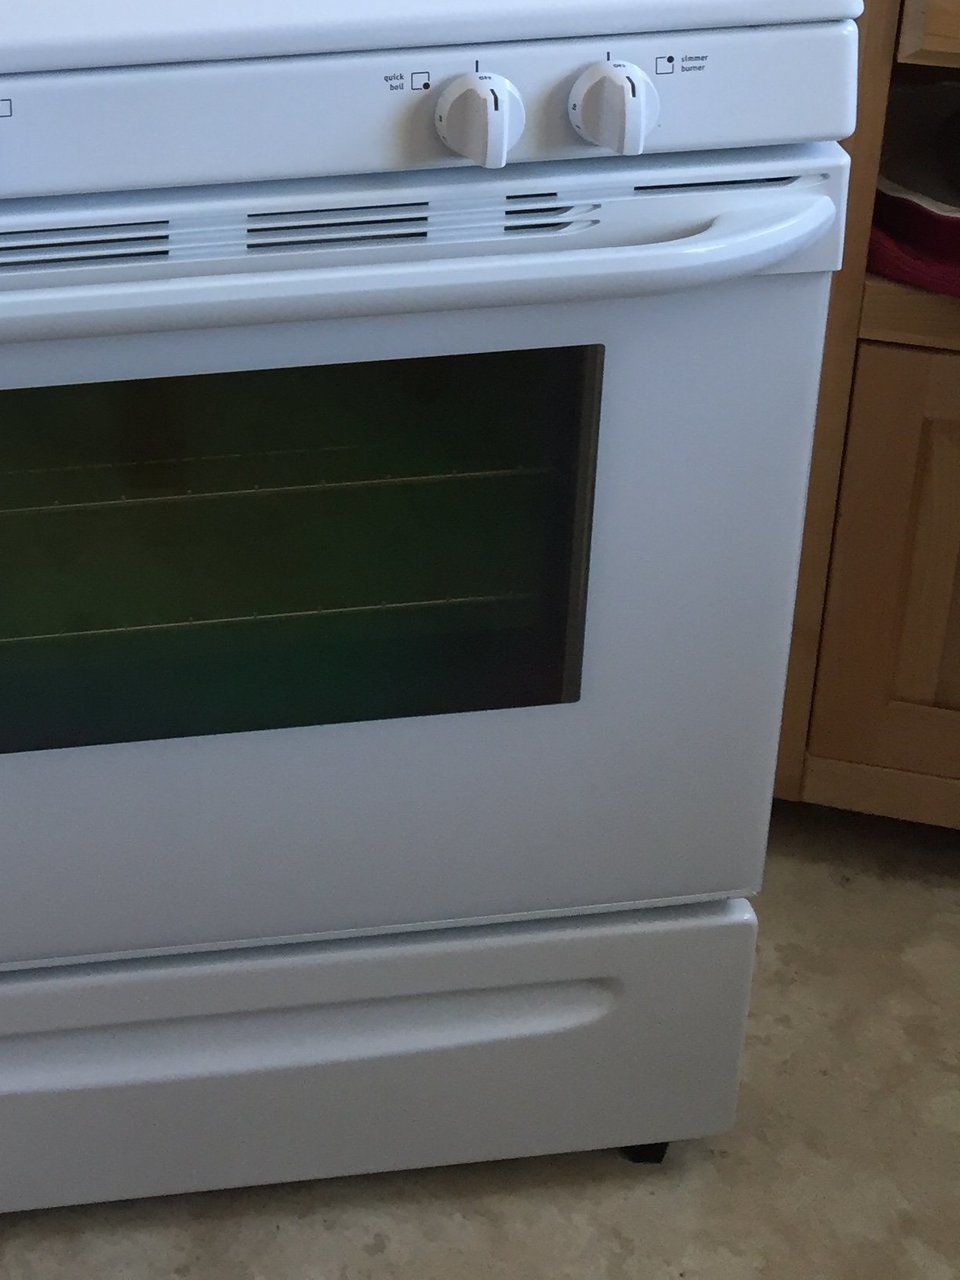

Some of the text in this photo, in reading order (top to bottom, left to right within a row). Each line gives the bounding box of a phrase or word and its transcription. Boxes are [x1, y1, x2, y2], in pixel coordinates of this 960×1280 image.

[681, 54, 708, 62] simmer
[384, 74, 405, 82] quick
[390, 83, 404, 91] boil
